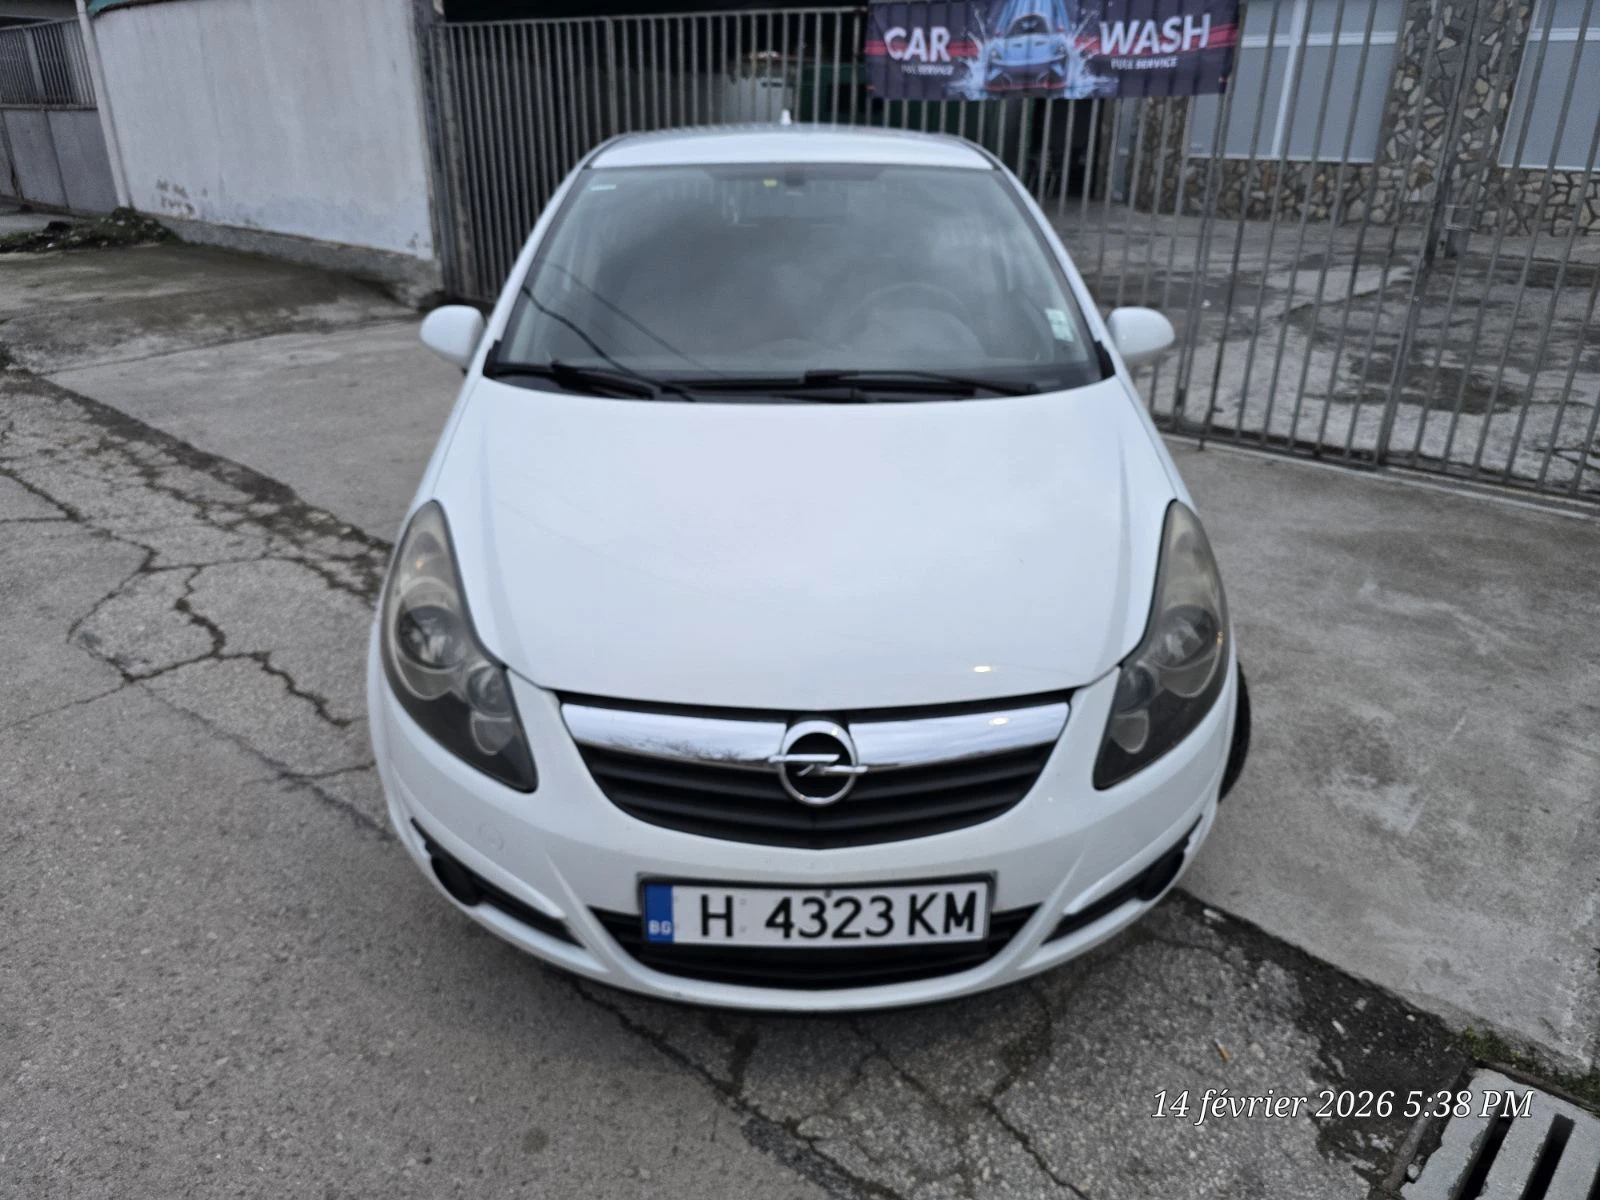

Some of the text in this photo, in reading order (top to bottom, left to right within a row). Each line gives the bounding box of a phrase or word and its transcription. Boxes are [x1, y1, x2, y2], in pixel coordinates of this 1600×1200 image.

[884, 13, 1211, 62] CAR WASH
[648, 919, 672, 935] BG
[701, 891, 977, 939] H 4323 KM
